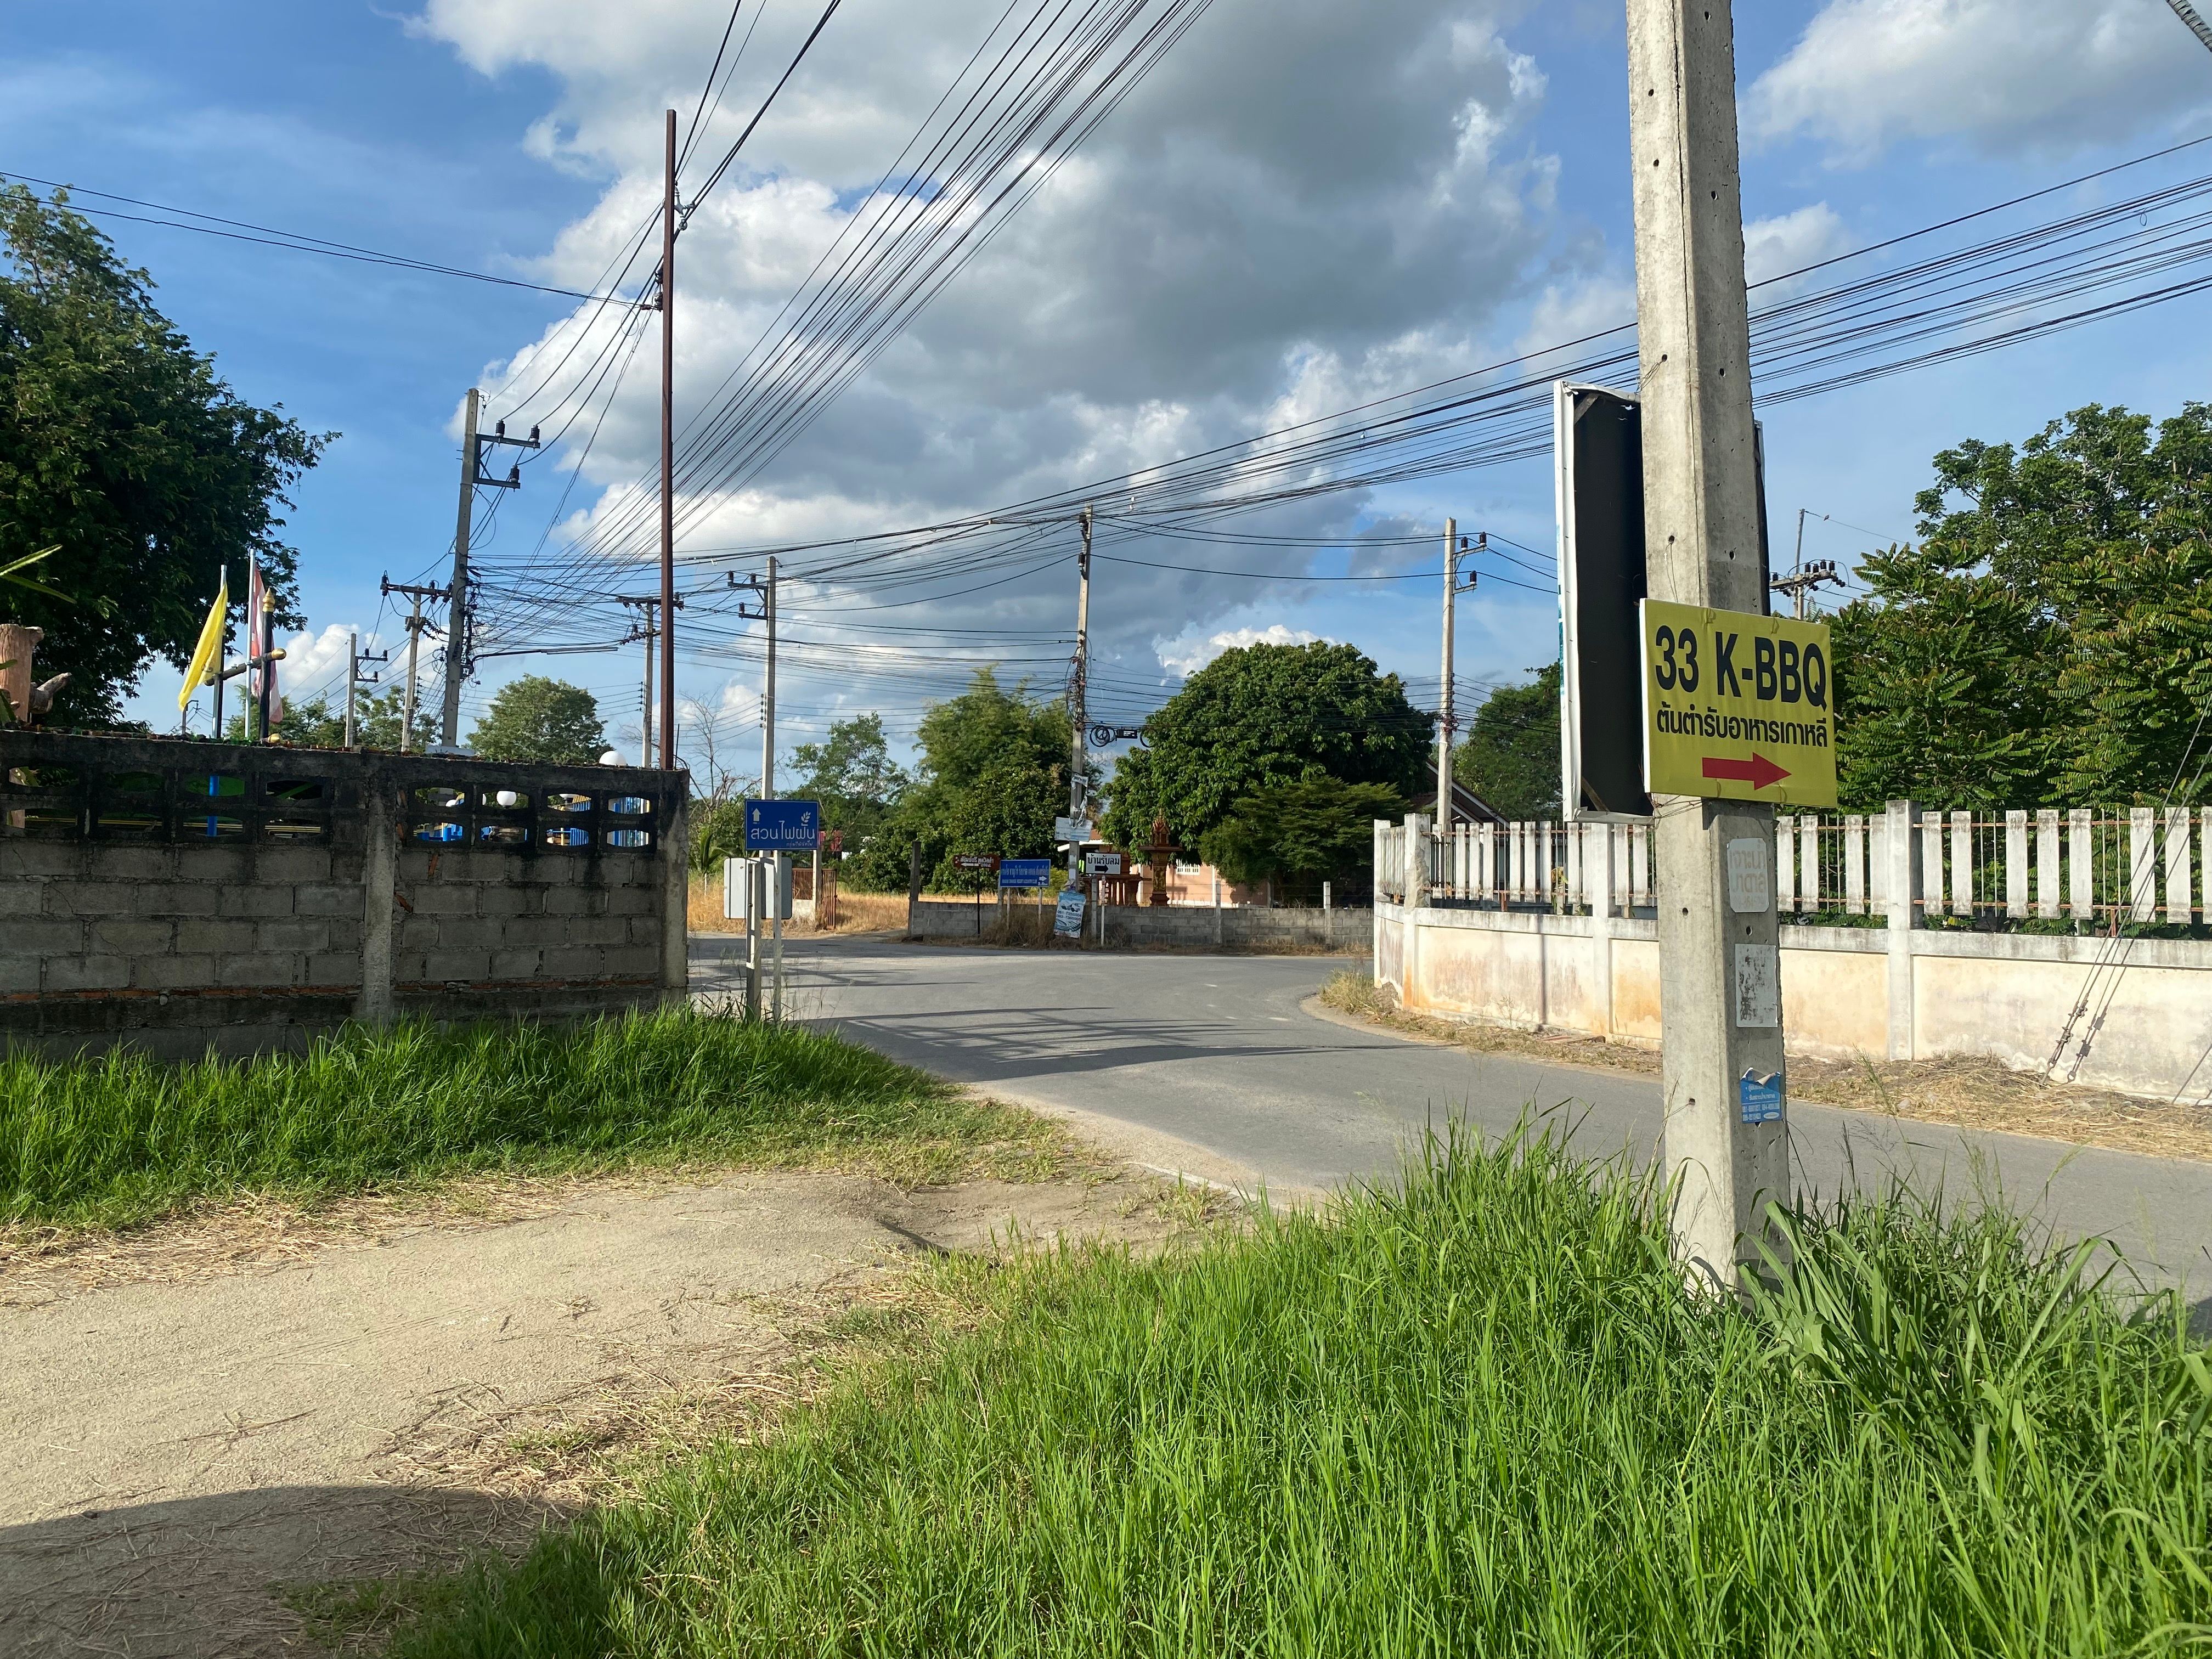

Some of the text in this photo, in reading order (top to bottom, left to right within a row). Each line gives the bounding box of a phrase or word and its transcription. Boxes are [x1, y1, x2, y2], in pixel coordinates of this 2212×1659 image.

[1656, 625, 1827, 712] 33 K-BBQ
[1657, 701, 1828, 748] ต้นตำรับอาหารเกาหลี
[1087, 853, 1120, 865] บ้านรับลม
